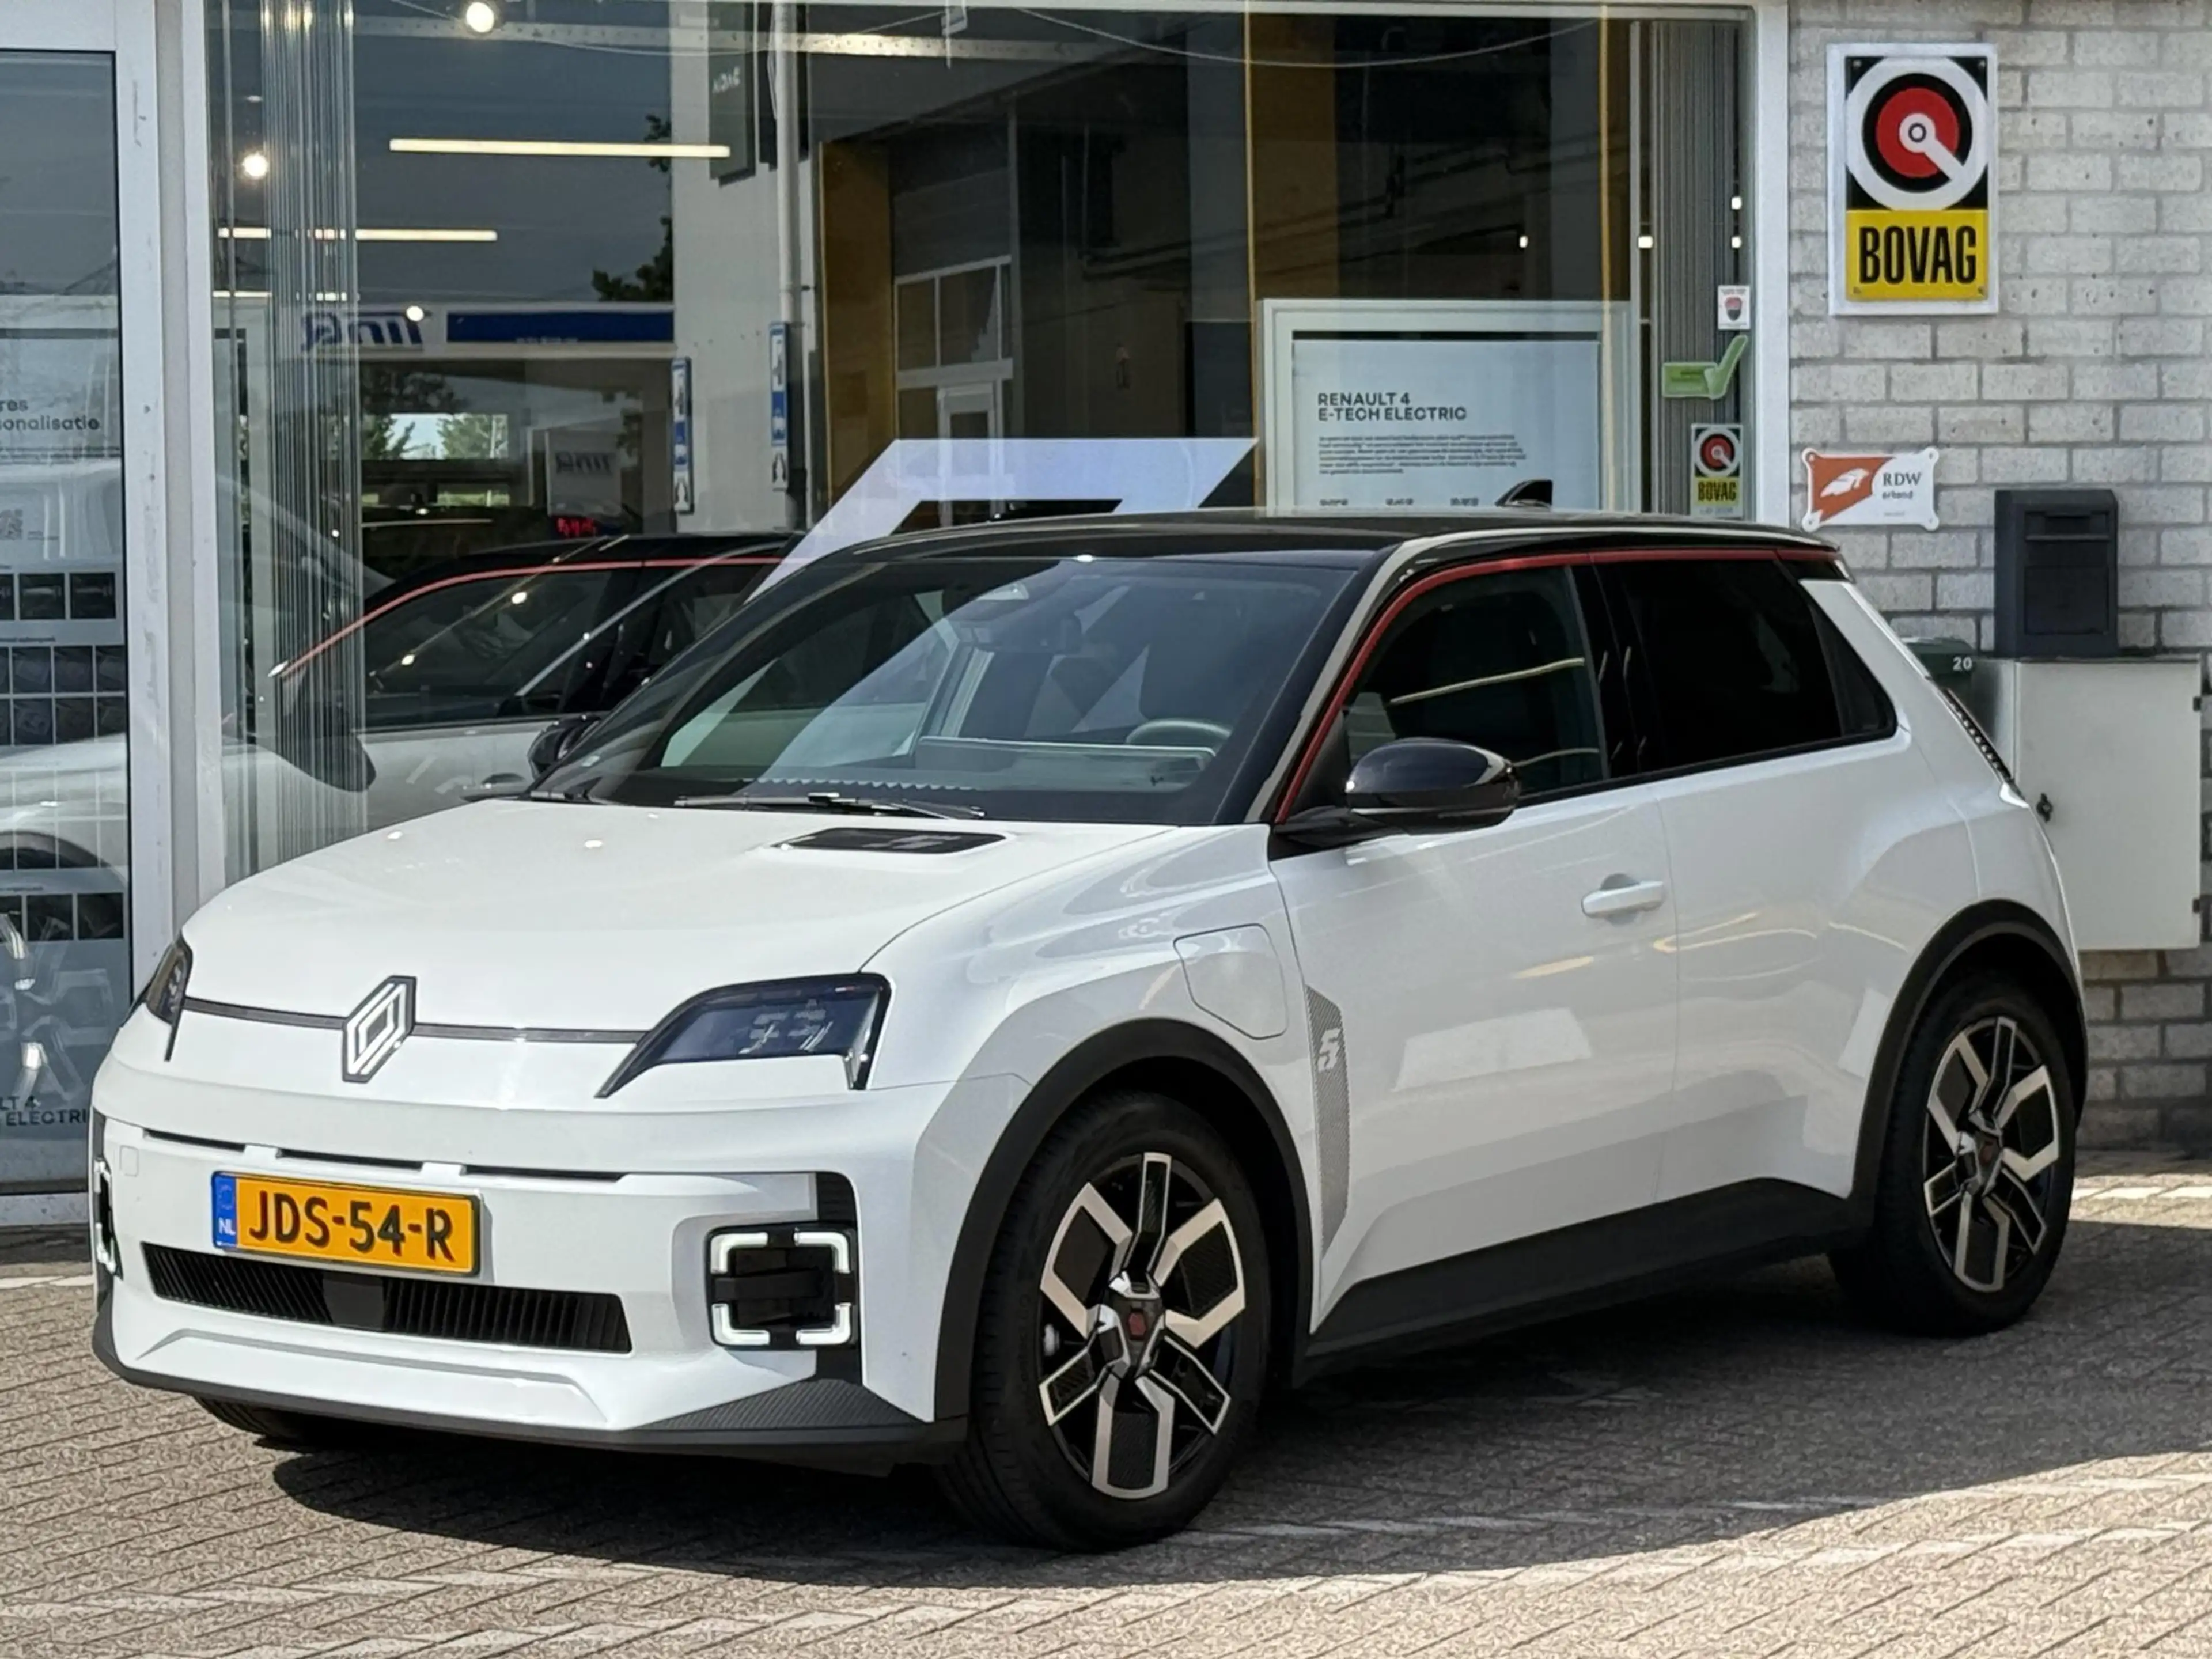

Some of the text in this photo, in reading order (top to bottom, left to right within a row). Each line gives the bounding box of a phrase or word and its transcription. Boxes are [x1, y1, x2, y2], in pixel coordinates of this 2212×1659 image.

[1859, 226, 1976, 284] BOVAG
[1318, 392, 1410, 406] RENAULT 4
[1319, 407, 1467, 421] E-TECH ELECTRIC
[1883, 472, 1922, 486] RDW
[1698, 482, 1737, 502] BOVAG
[1953, 657, 1972, 671] 20
[6, 1109, 86, 1126] ELECTRI
[219, 1190, 456, 1262] NL JDS-54-R
